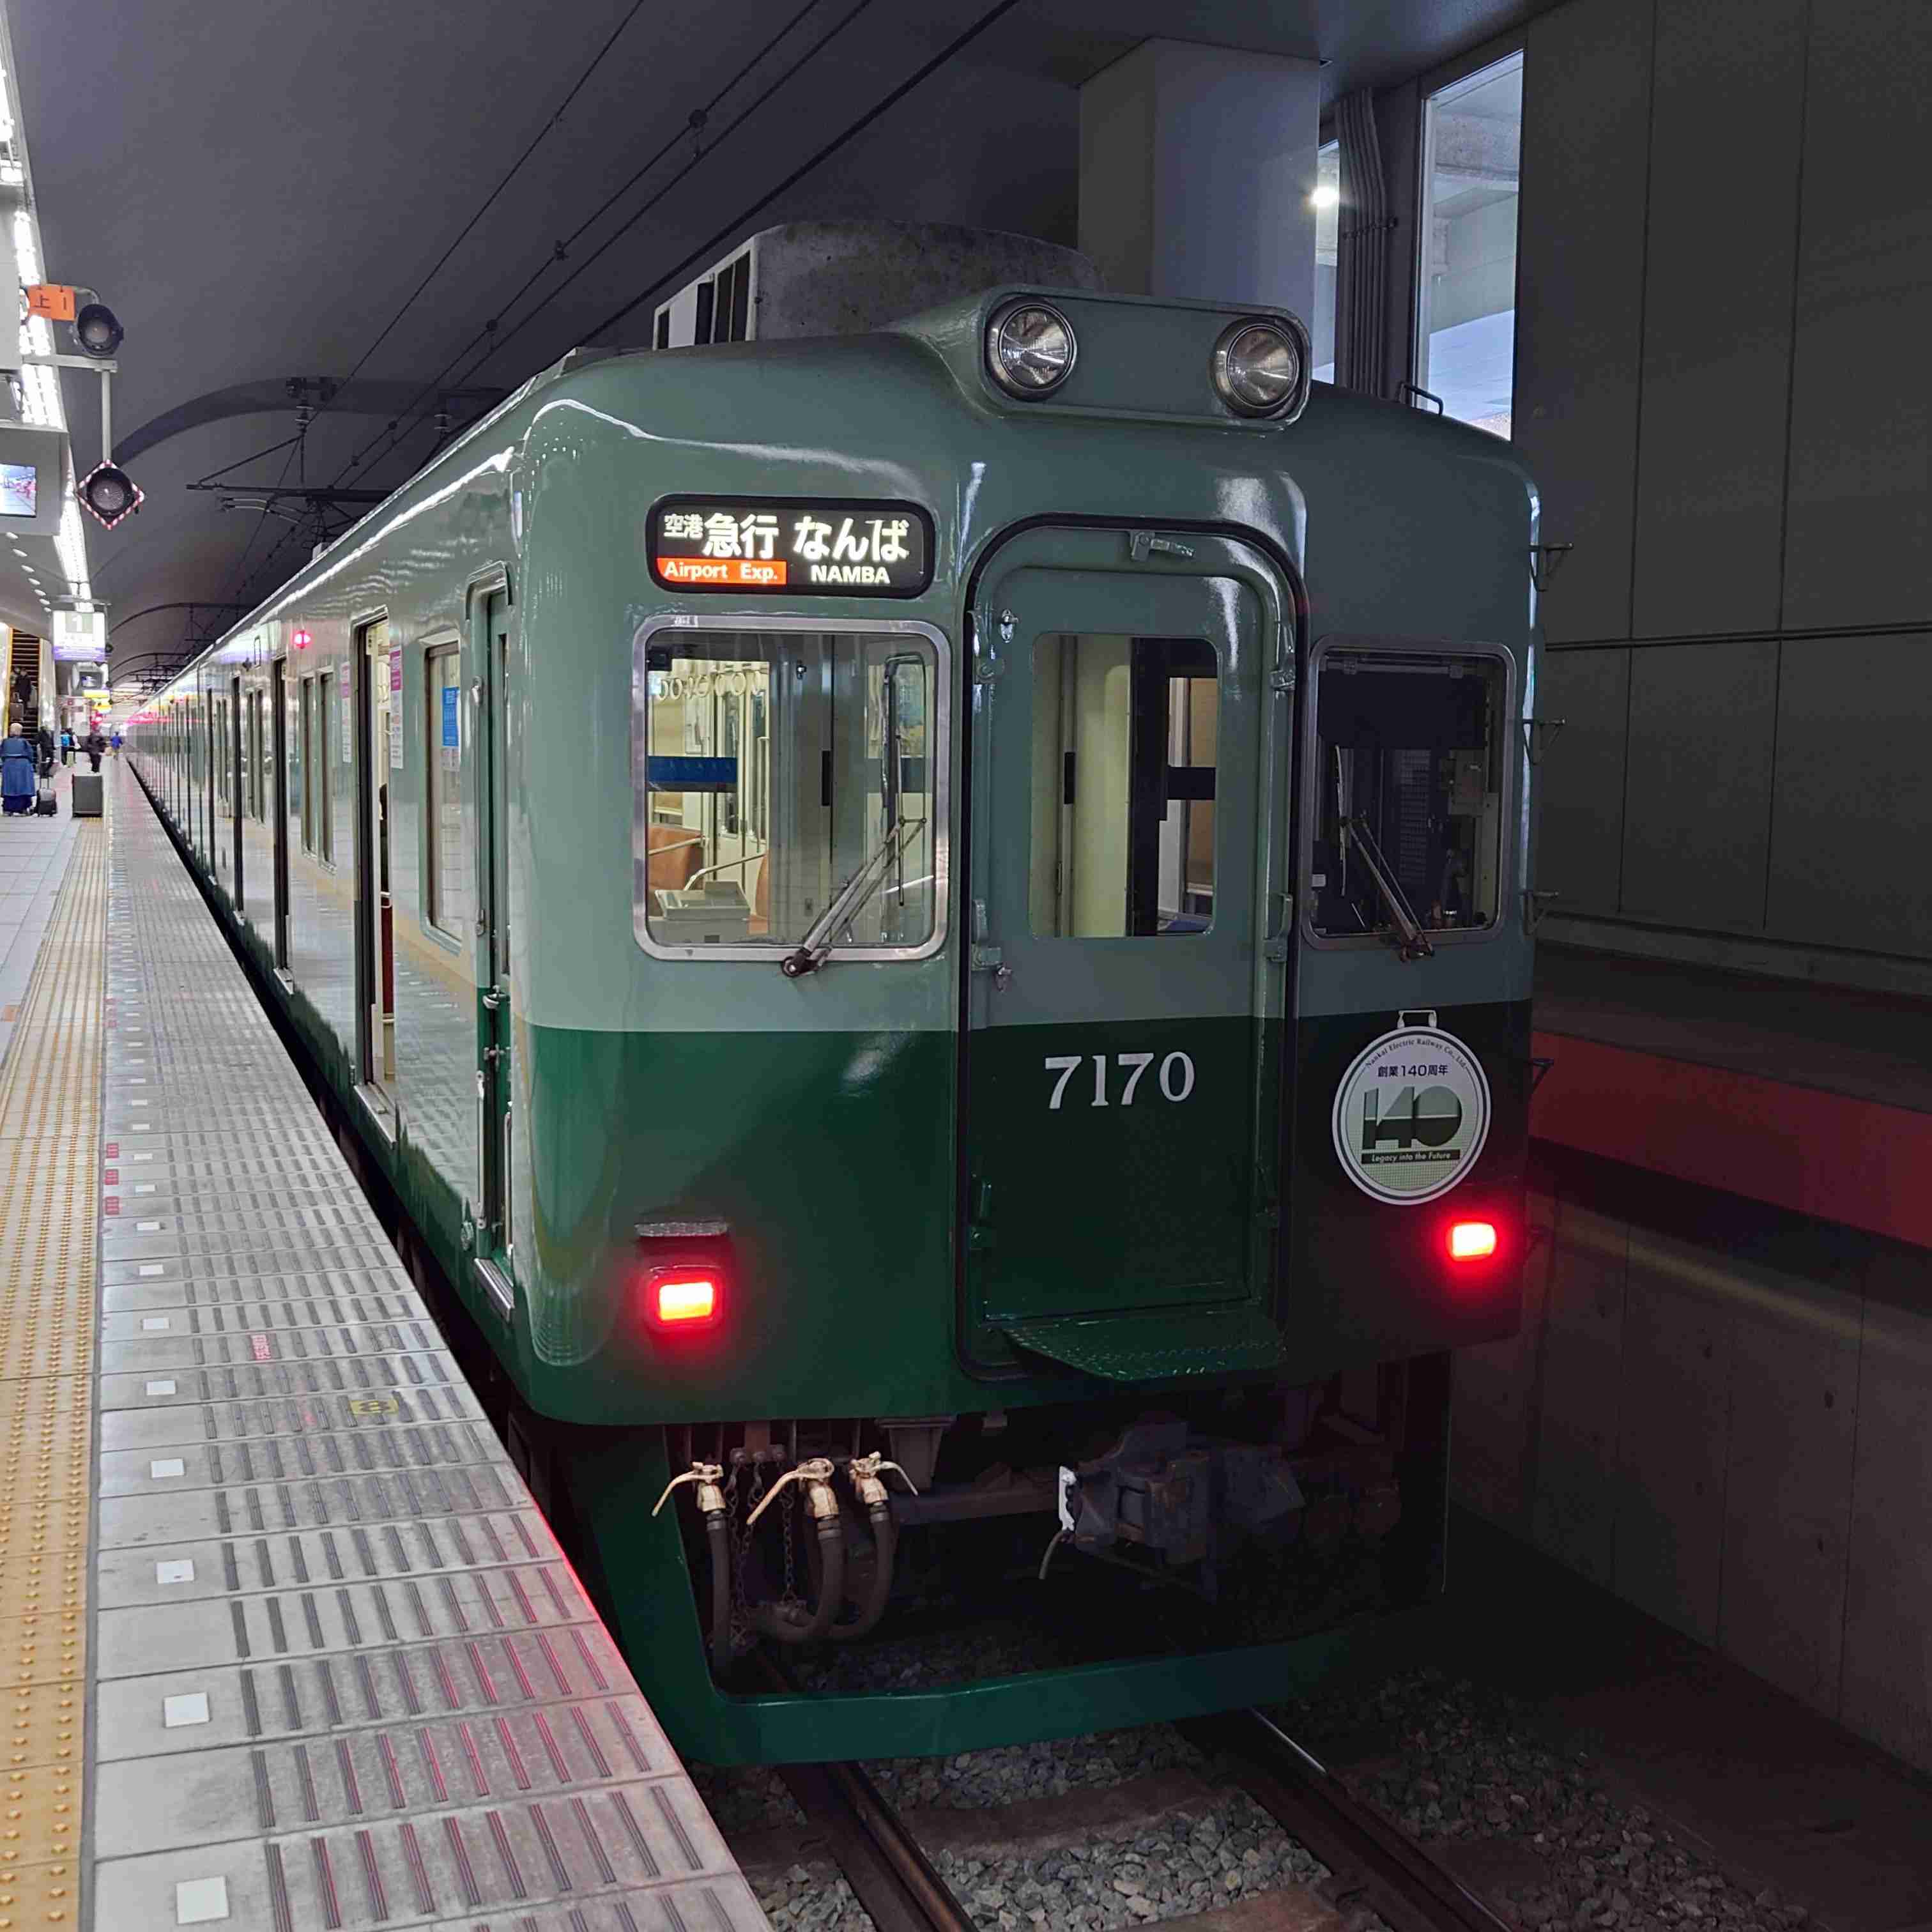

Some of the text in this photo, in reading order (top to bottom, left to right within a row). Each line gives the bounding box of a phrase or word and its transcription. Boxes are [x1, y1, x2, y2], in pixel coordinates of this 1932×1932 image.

[664, 513, 910, 562] 空港急行 なんば
[664, 560, 778, 581] Airport Exp.
[810, 564, 891, 585] NAMBA
[1388, 1039, 1415, 1051] Electric
[1416, 1038, 1443, 1050] Railway
[1045, 1051, 1195, 1110] 7170
[1377, 1064, 1449, 1077] 創業140周年
[1371, 1151, 1452, 1163] Legacy into the Future
